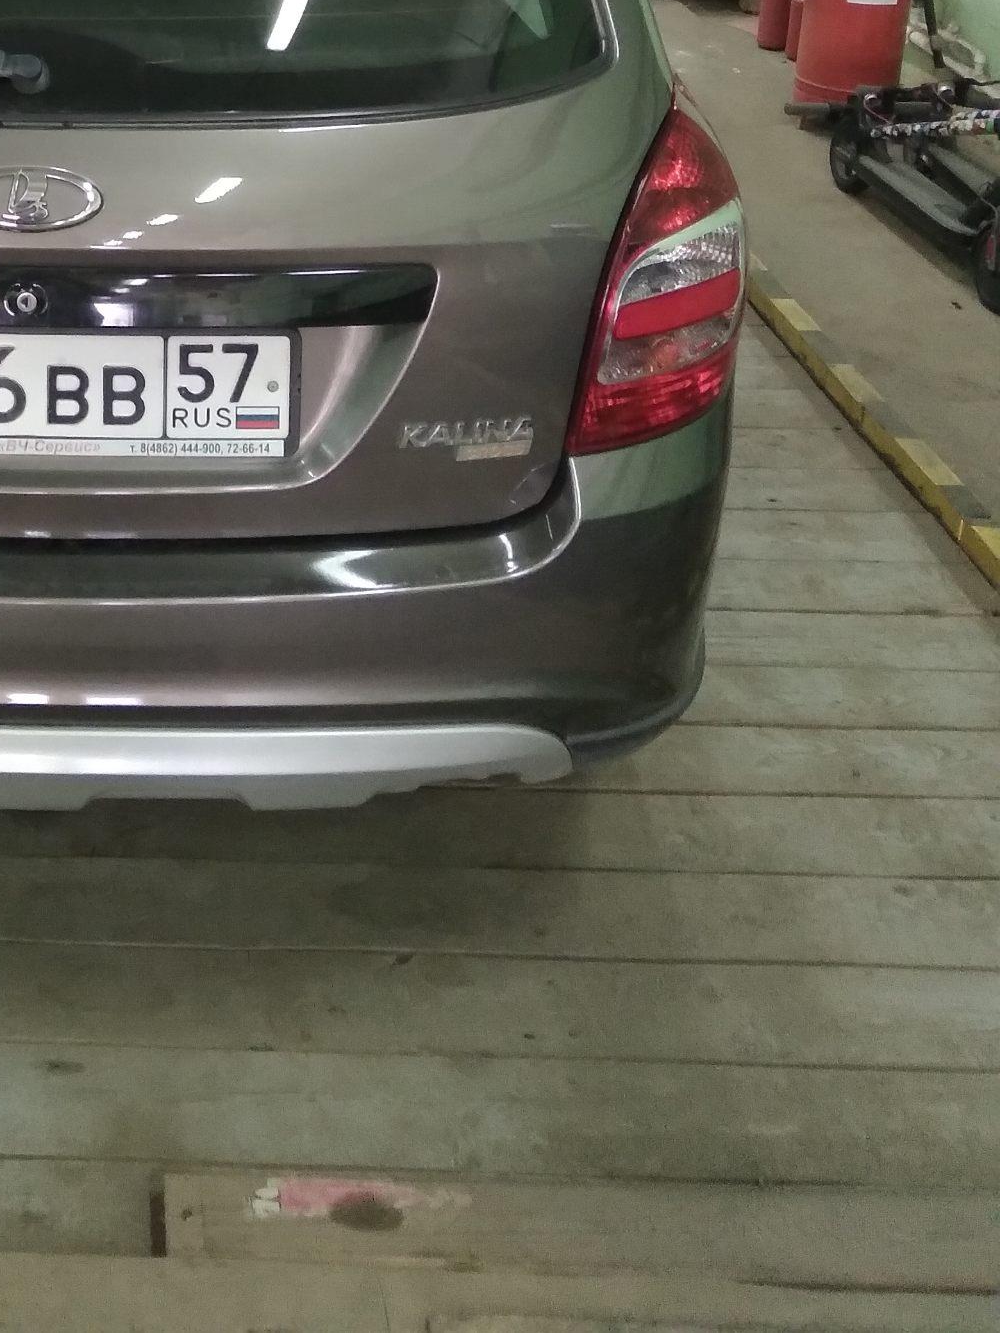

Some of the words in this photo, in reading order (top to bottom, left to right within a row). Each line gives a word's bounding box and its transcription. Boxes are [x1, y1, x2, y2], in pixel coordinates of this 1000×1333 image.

[177, 343, 259, 403] 57
[172, 407, 233, 429] RUS
[140, 442, 178, 455] 8(4862)
[180, 443, 223, 455] 444-900,
[226, 443, 270, 454] 72-66-14
